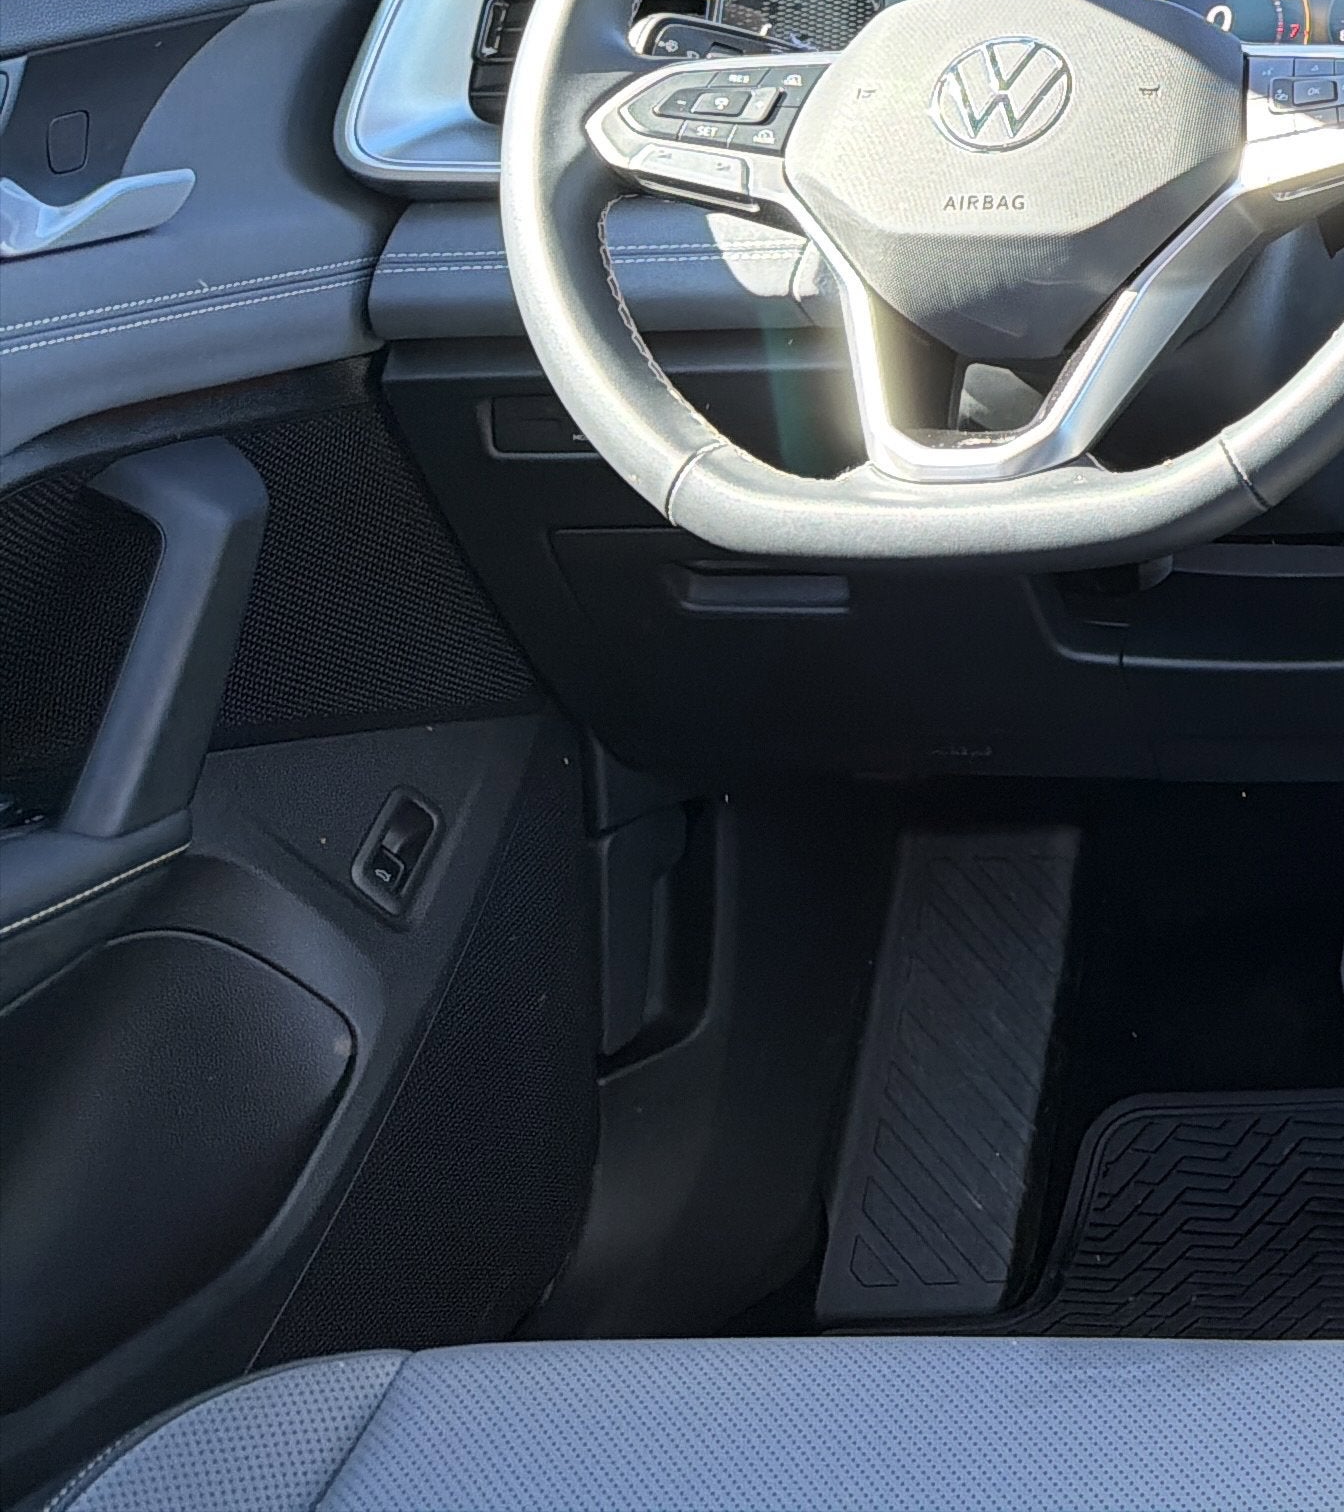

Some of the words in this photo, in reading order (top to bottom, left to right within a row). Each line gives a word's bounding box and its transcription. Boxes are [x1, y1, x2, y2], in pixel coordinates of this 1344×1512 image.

[1288, 24, 1299, 37] 7
[696, 126, 718, 137] SET
[942, 194, 1026, 211] AIRBAG
